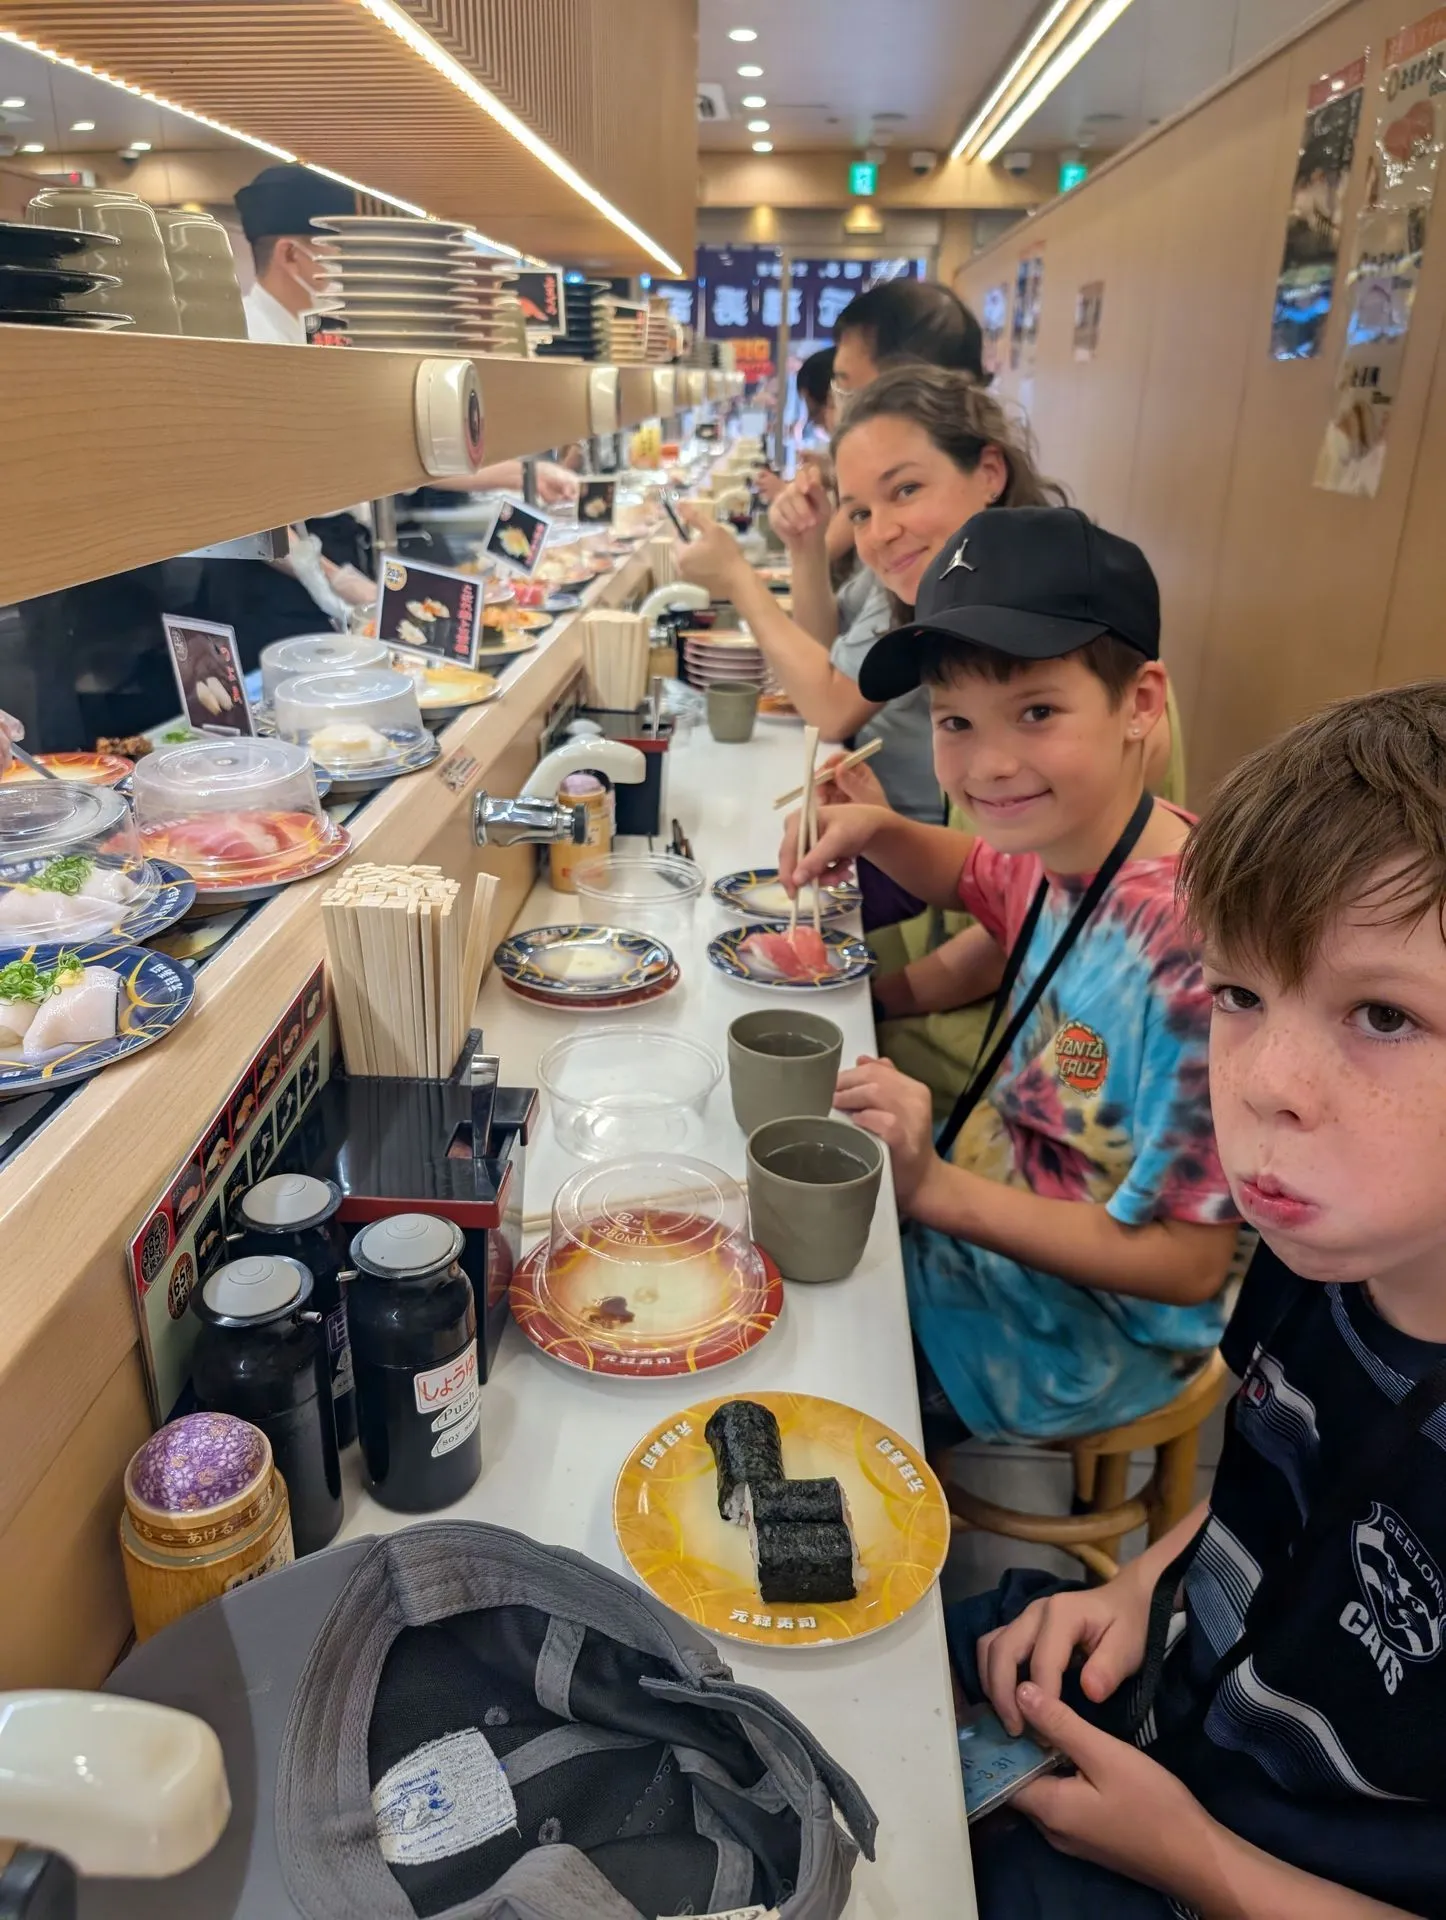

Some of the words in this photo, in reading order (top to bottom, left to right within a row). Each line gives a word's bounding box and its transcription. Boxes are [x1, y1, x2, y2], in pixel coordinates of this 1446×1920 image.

[1056, 1038, 1104, 1059] SANTA
[1060, 1058, 1100, 1079] CRUZ
[421, 1354, 476, 1402] しょうゆ
[443, 1390, 477, 1422] Push
[442, 1432, 462, 1447] soy
[187, 1522, 235, 1545] あける
[1338, 1600, 1404, 1696] CATS
